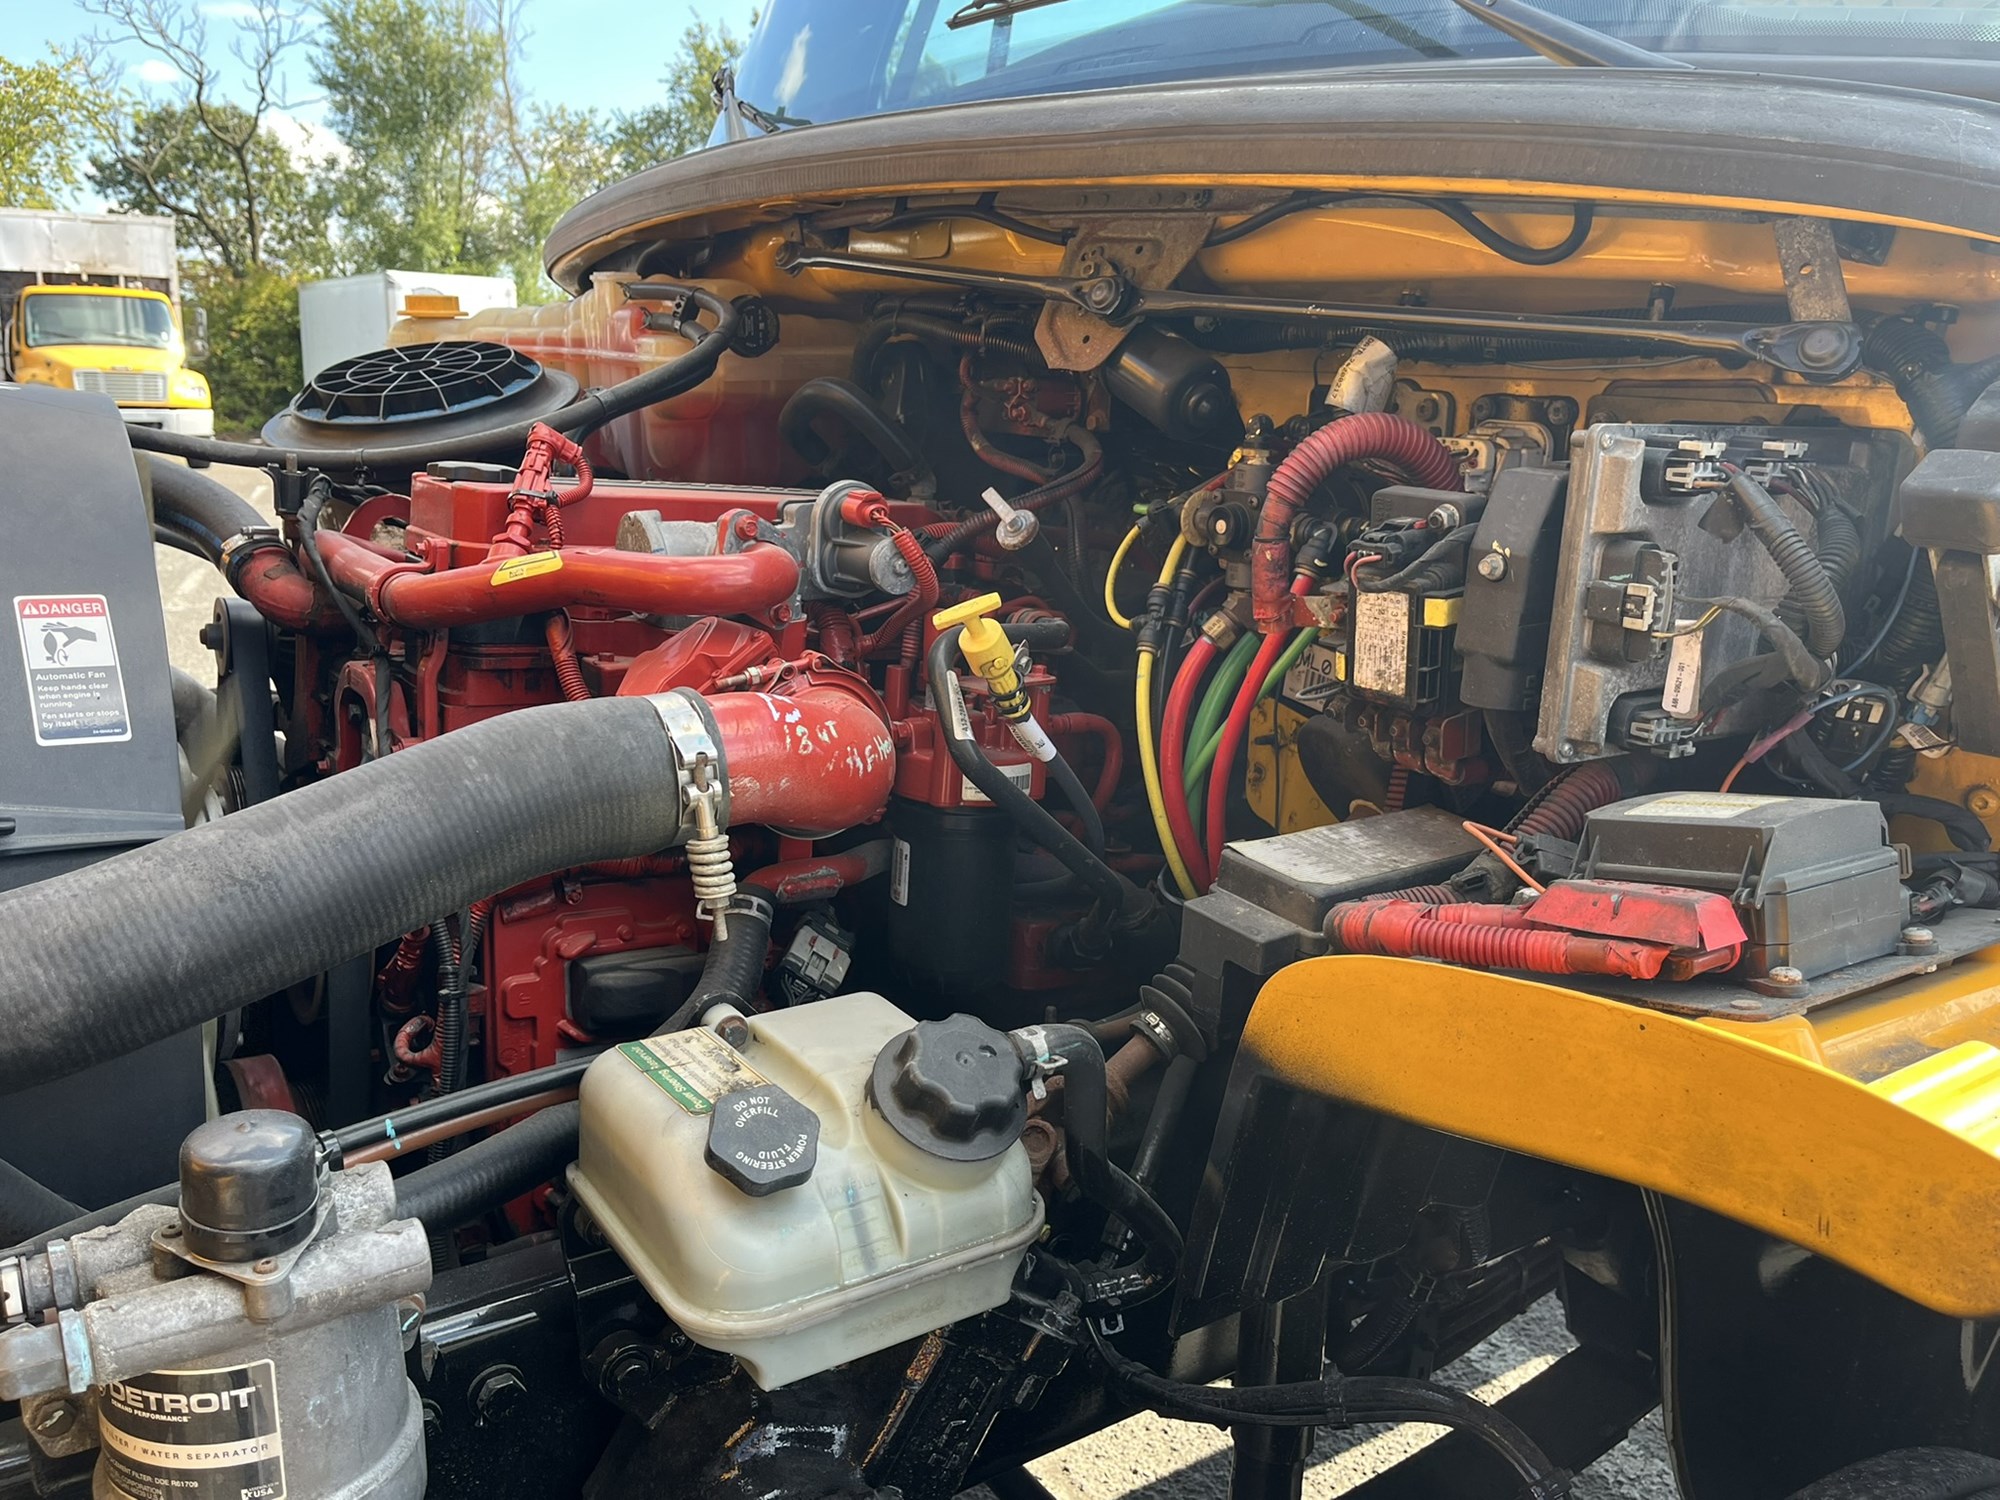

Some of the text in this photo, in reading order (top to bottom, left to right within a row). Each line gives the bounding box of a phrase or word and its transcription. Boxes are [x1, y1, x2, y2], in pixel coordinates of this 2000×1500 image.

[39, 603, 103, 614] DANGER
[36, 671, 106, 681] Automatic Fan
[39, 692, 61, 700] when
[63, 691, 91, 699] engine
[59, 710, 84, 718] starts
[43, 721, 53, 729] by
[658, 1068, 687, 1093] Steering
[683, 1091, 707, 1109] Power
[733, 1096, 770, 1111] DO NOT
[735, 1106, 779, 1128] OVERFILL
[735, 1134, 808, 1170] POWER STEERING
[758, 1143, 792, 1160] FLUID
[110, 1381, 256, 1414] DETROIT
[142, 1447, 180, 1460] WATER
[186, 1443, 269, 1460] SEPARATOR
[254, 1487, 274, 1498] USA
